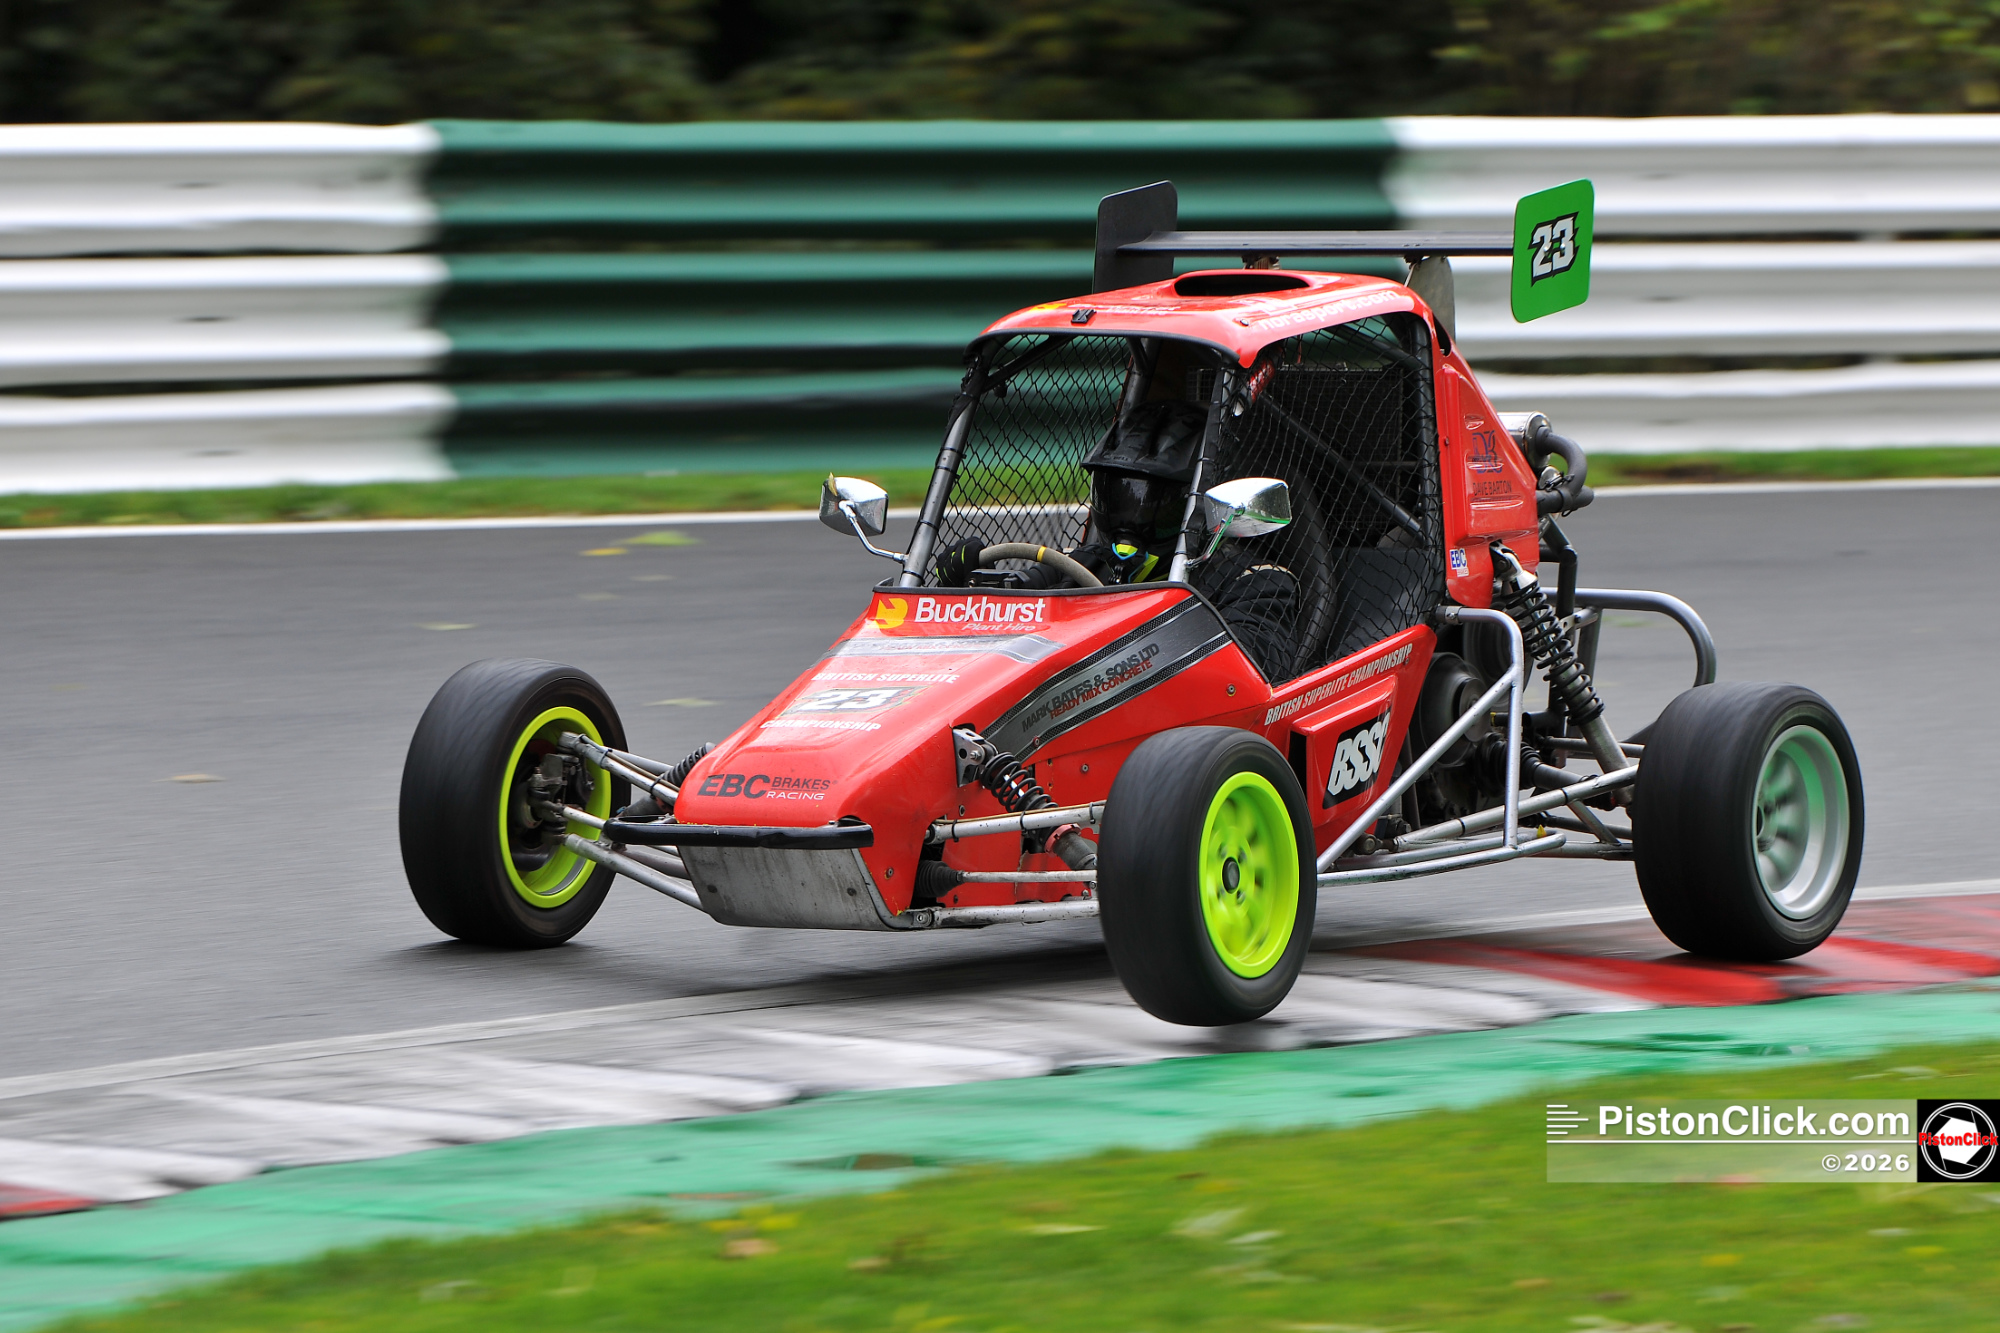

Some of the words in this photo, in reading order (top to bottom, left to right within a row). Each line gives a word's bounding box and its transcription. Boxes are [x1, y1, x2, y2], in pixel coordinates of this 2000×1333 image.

[1530, 213, 1577, 281] 23
[1258, 290, 1400, 329] norasport.com
[1451, 549, 1467, 569] EBC
[915, 597, 1046, 623] Buckhurst
[961, 622, 1002, 632] Plant
[1005, 622, 1036, 632] Hire
[811, 672, 876, 682] BRITISH
[877, 672, 960, 684] SUPERLITE
[1022, 700, 1053, 733] MARK
[1051, 679, 1093, 709] BATES
[1094, 673, 1105, 687] &
[1105, 653, 1140, 681] SONS
[1139, 643, 1160, 661] LTD
[1050, 695, 1081, 720] READY
[1081, 686, 1102, 703] MIX
[1101, 660, 1153, 692] CONCRETE
[1264, 694, 1304, 726] BRITISH
[1302, 673, 1350, 709] SUPERLITE
[1347, 643, 1413, 688] CHAMPIONSHIP
[797, 688, 905, 712] 23
[760, 719, 882, 732] CHAMPIONSHIP
[697, 773, 771, 799] EBC
[772, 776, 831, 791] BRAKES
[766, 791, 826, 801] RACING
